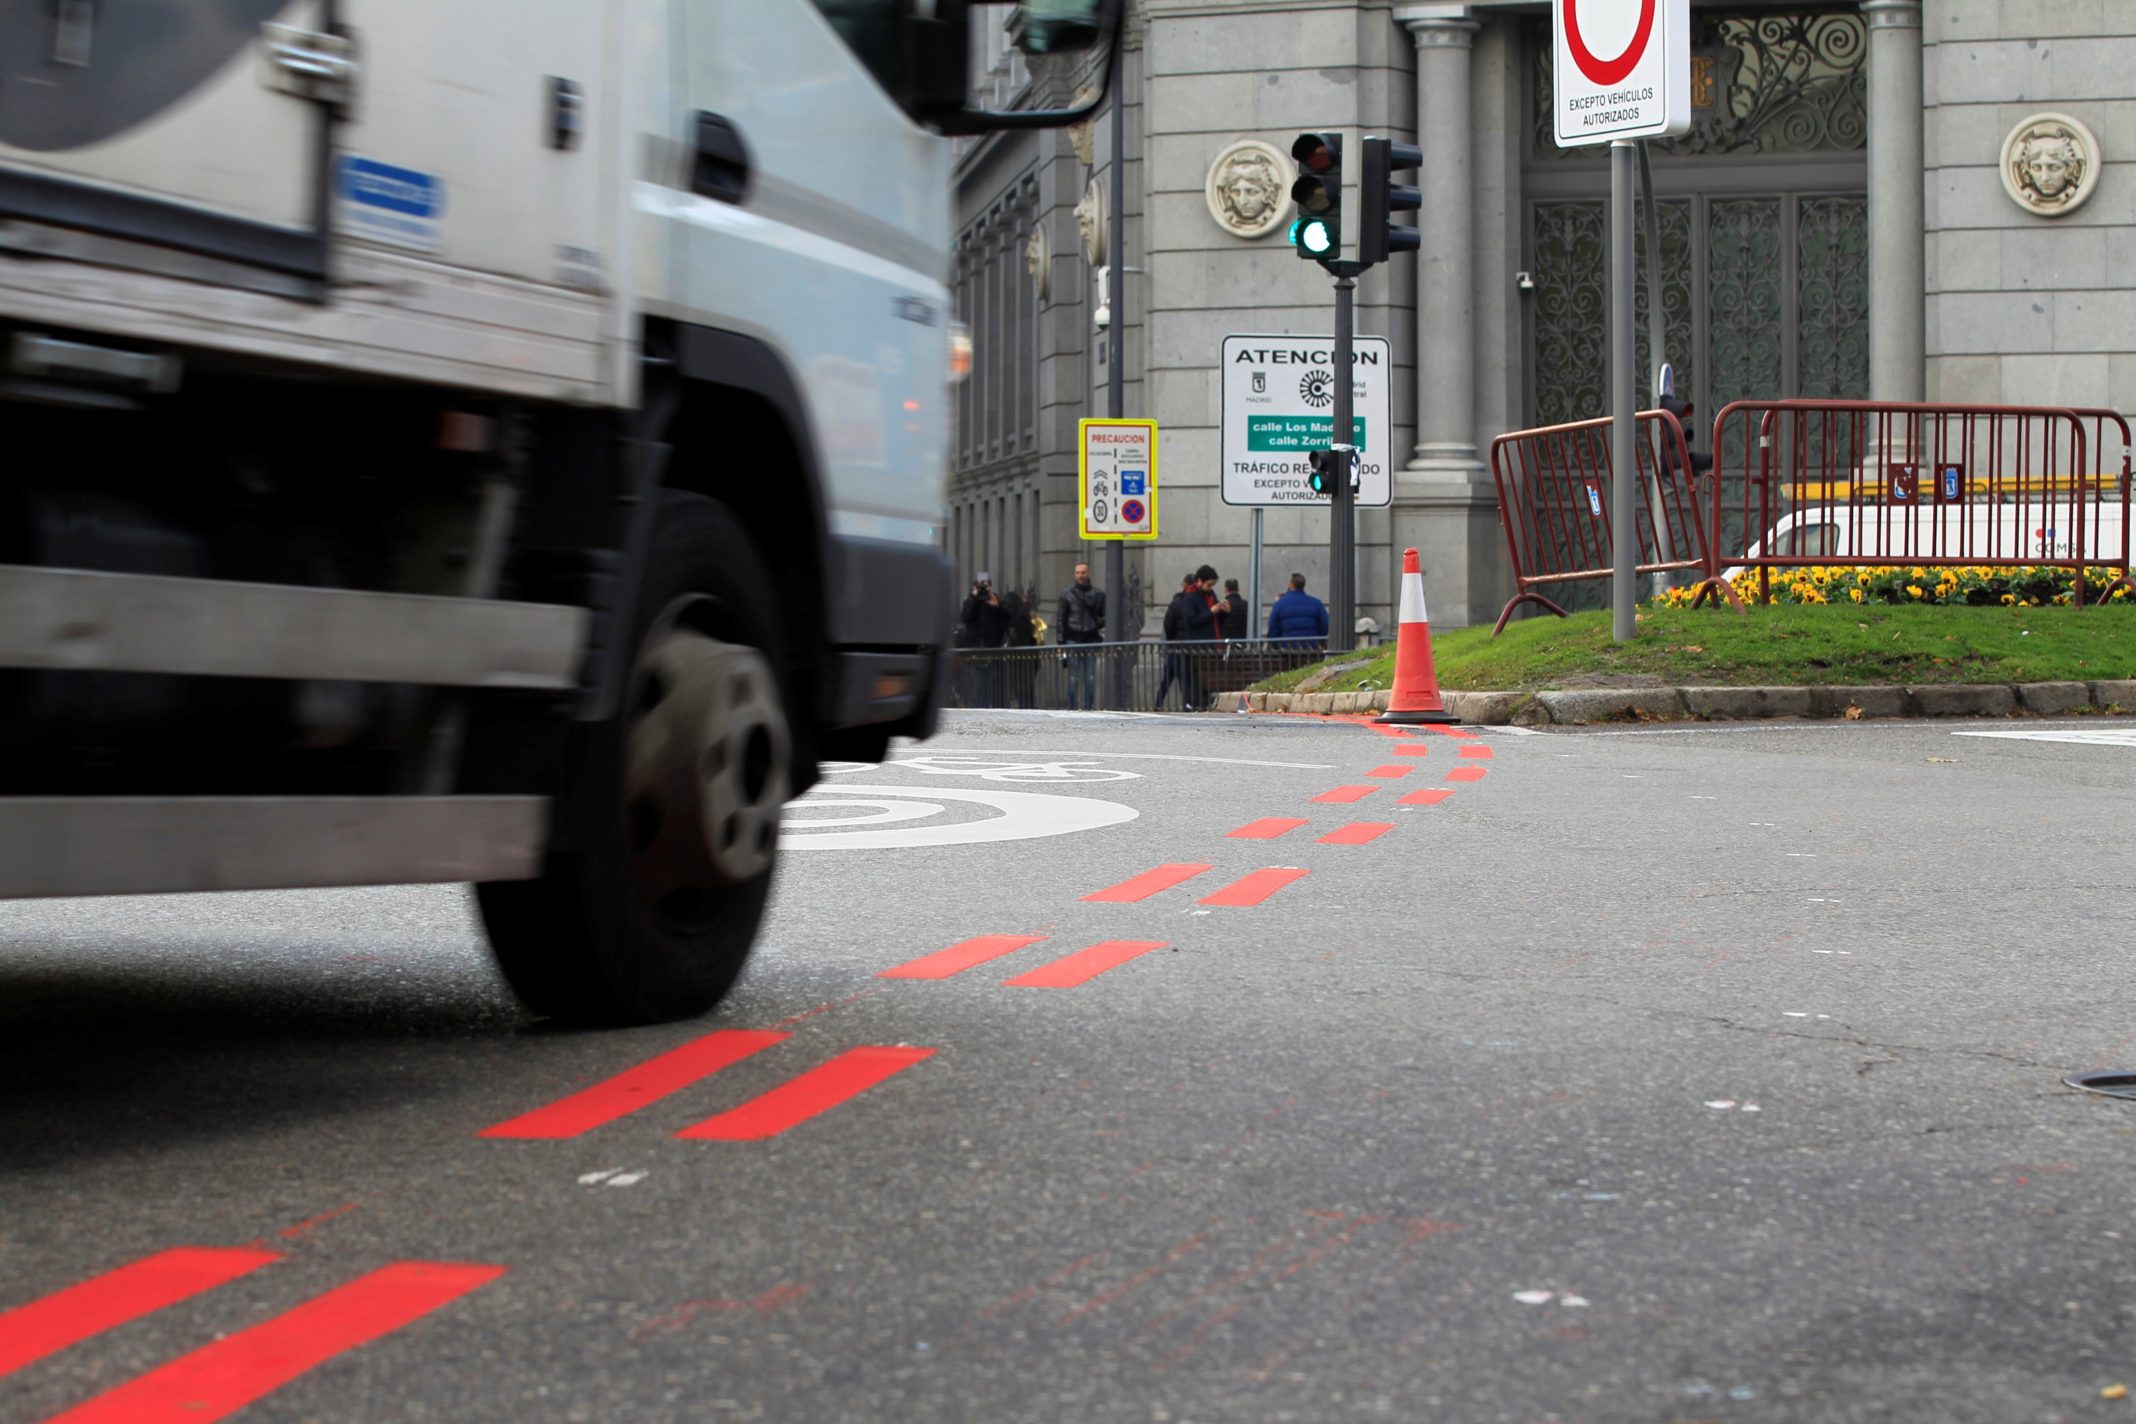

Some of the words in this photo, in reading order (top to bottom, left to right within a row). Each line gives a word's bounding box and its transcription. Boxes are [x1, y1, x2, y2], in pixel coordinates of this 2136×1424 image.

[1569, 95, 1606, 111] EXCEPTO
[1607, 87, 1653, 104] VEHÍCULOS
[1583, 107, 1640, 126] AUTORIZADOS
[1253, 422, 1282, 432] calle
[1286, 422, 1307, 432] Los
[1269, 436, 1298, 446] calle
[1234, 461, 1289, 474] TRÁFICO
[1254, 479, 1300, 488] EXCEPTO
